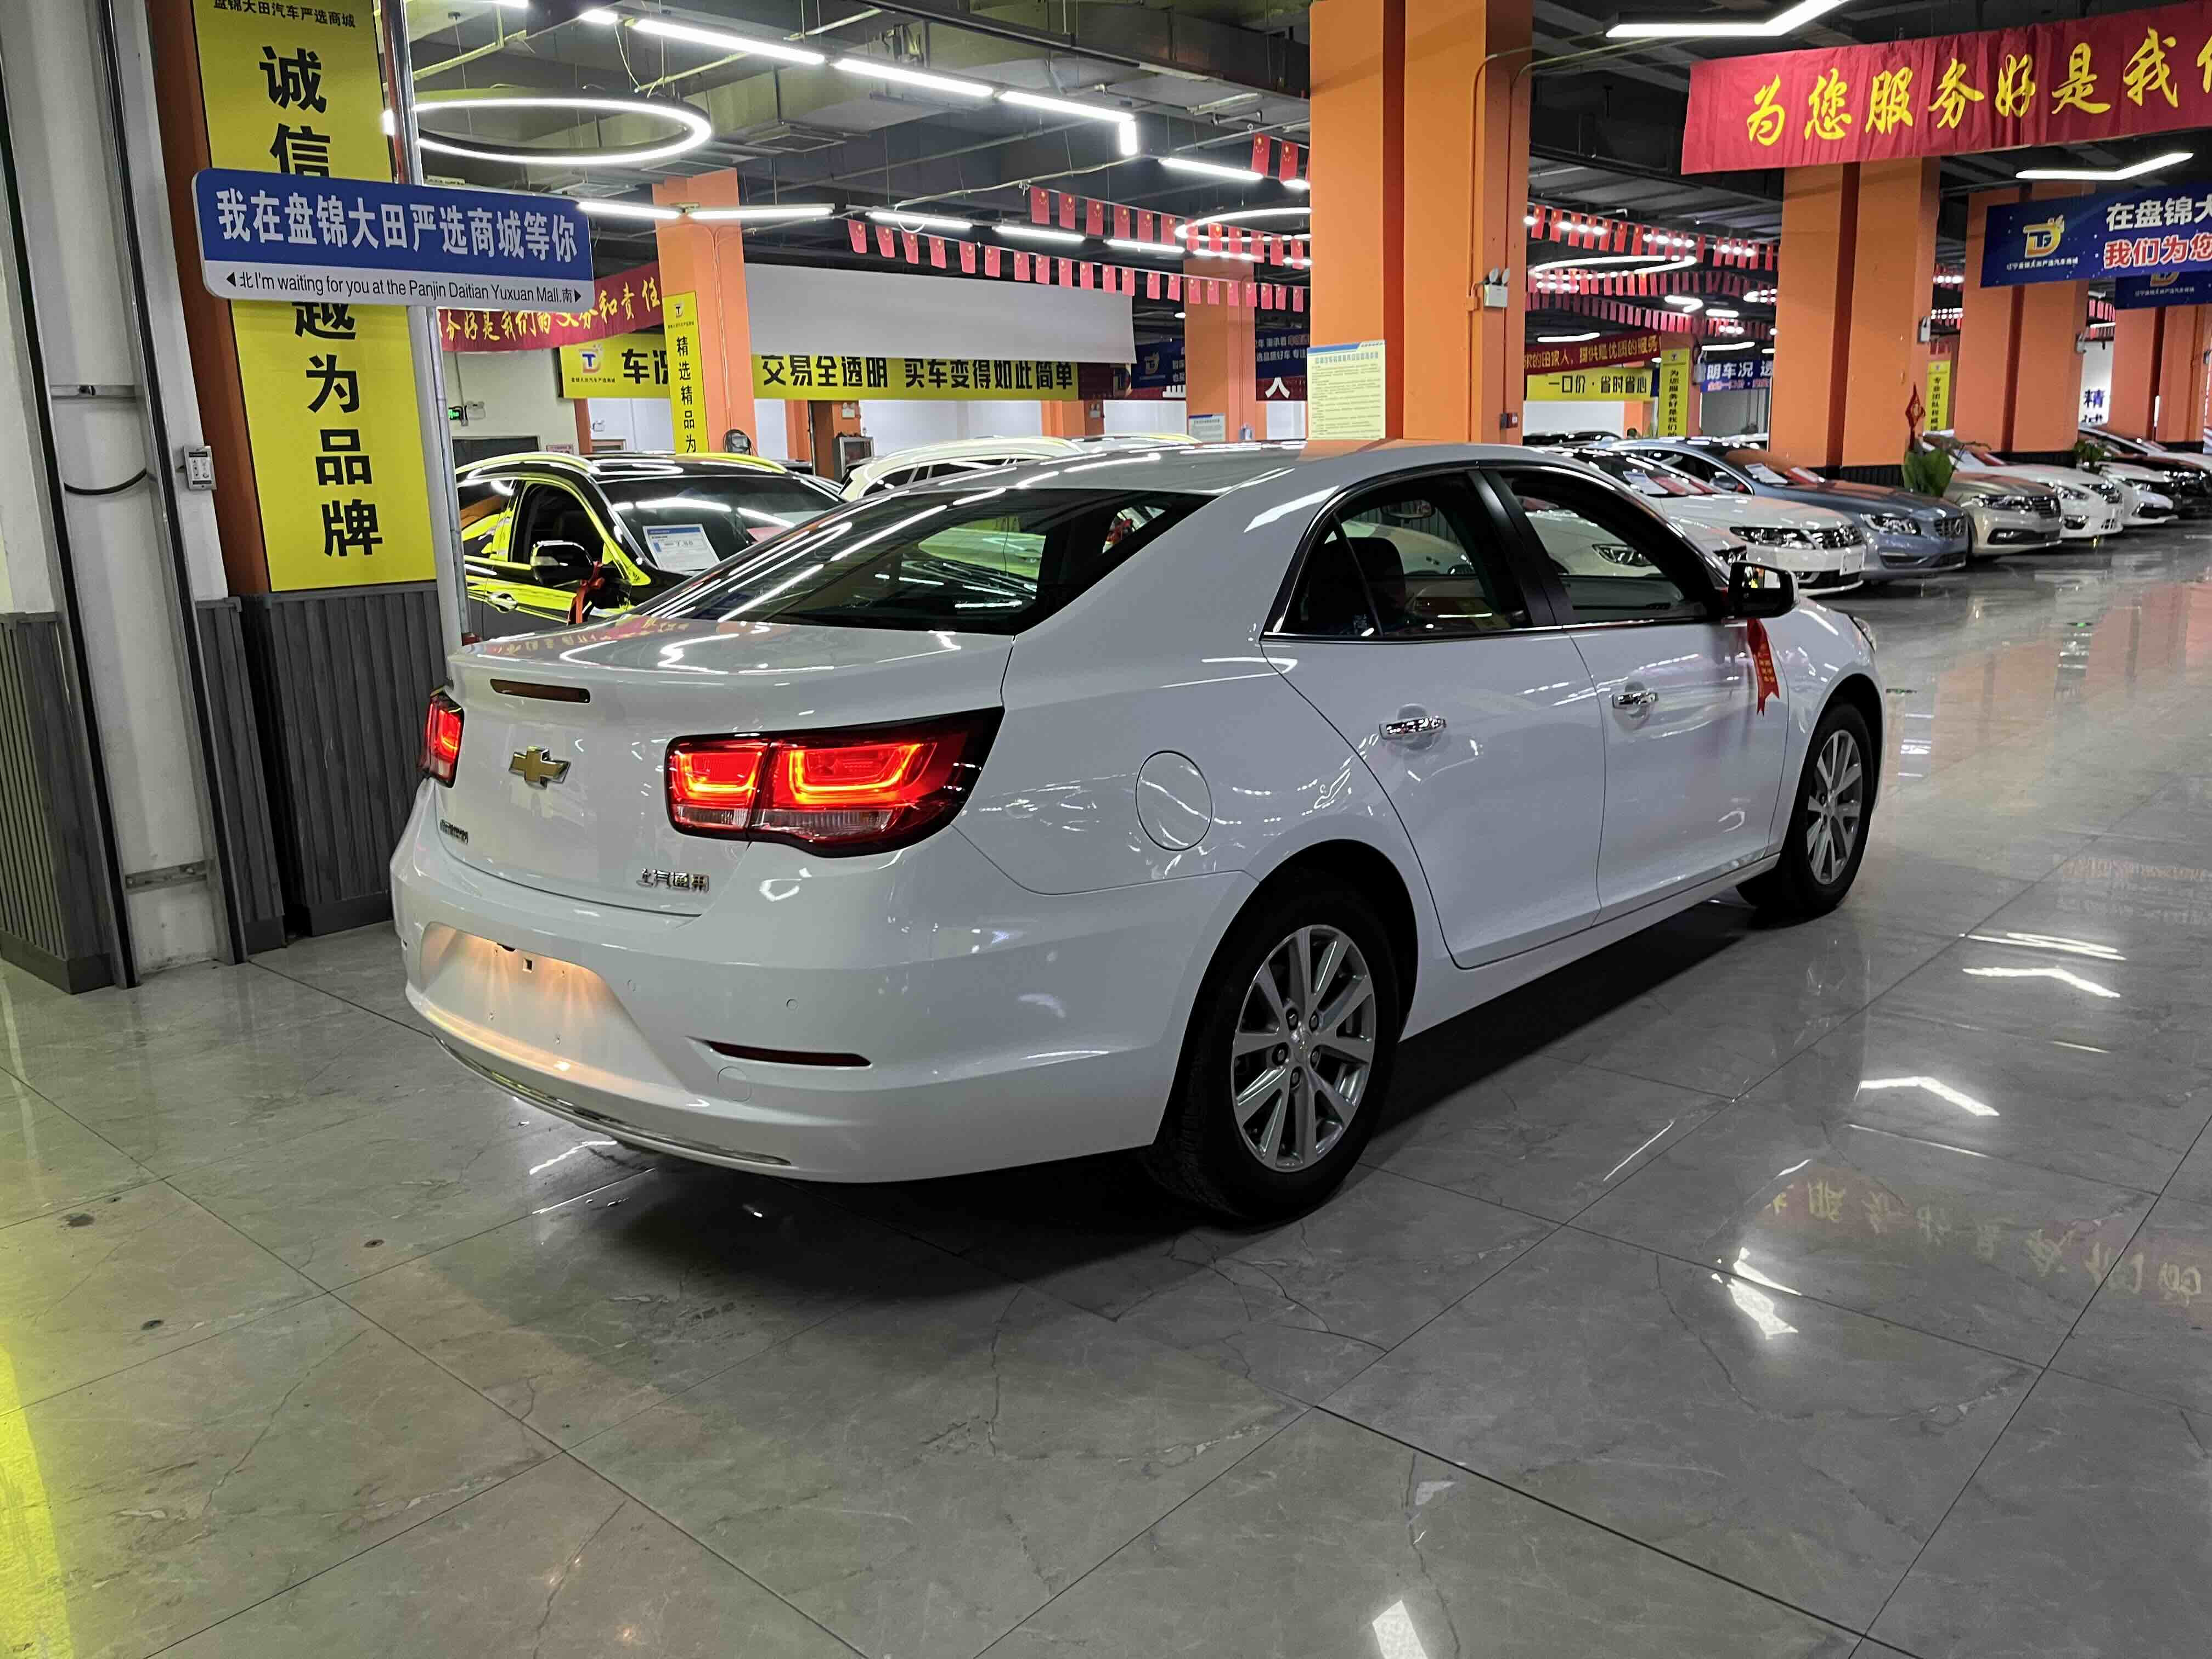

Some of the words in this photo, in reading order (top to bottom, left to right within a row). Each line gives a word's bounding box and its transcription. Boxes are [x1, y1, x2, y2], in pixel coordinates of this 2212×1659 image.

[217, 188, 578, 263] 我在盘锦大田严选商城等你
[255, 272, 274, 289] I'm
[277, 274, 324, 296] waiting
[326, 276, 343, 292] for
[346, 280, 369, 297] you
[373, 279, 383, 294] at
[386, 279, 406, 295] the
[409, 280, 446, 301] Panjin
[449, 282, 488, 300] Daitian
[492, 284, 534, 301] Yuxuan
[761, 355, 888, 388] 交易全透明
[904, 358, 1073, 390] 买车变得如此简单
